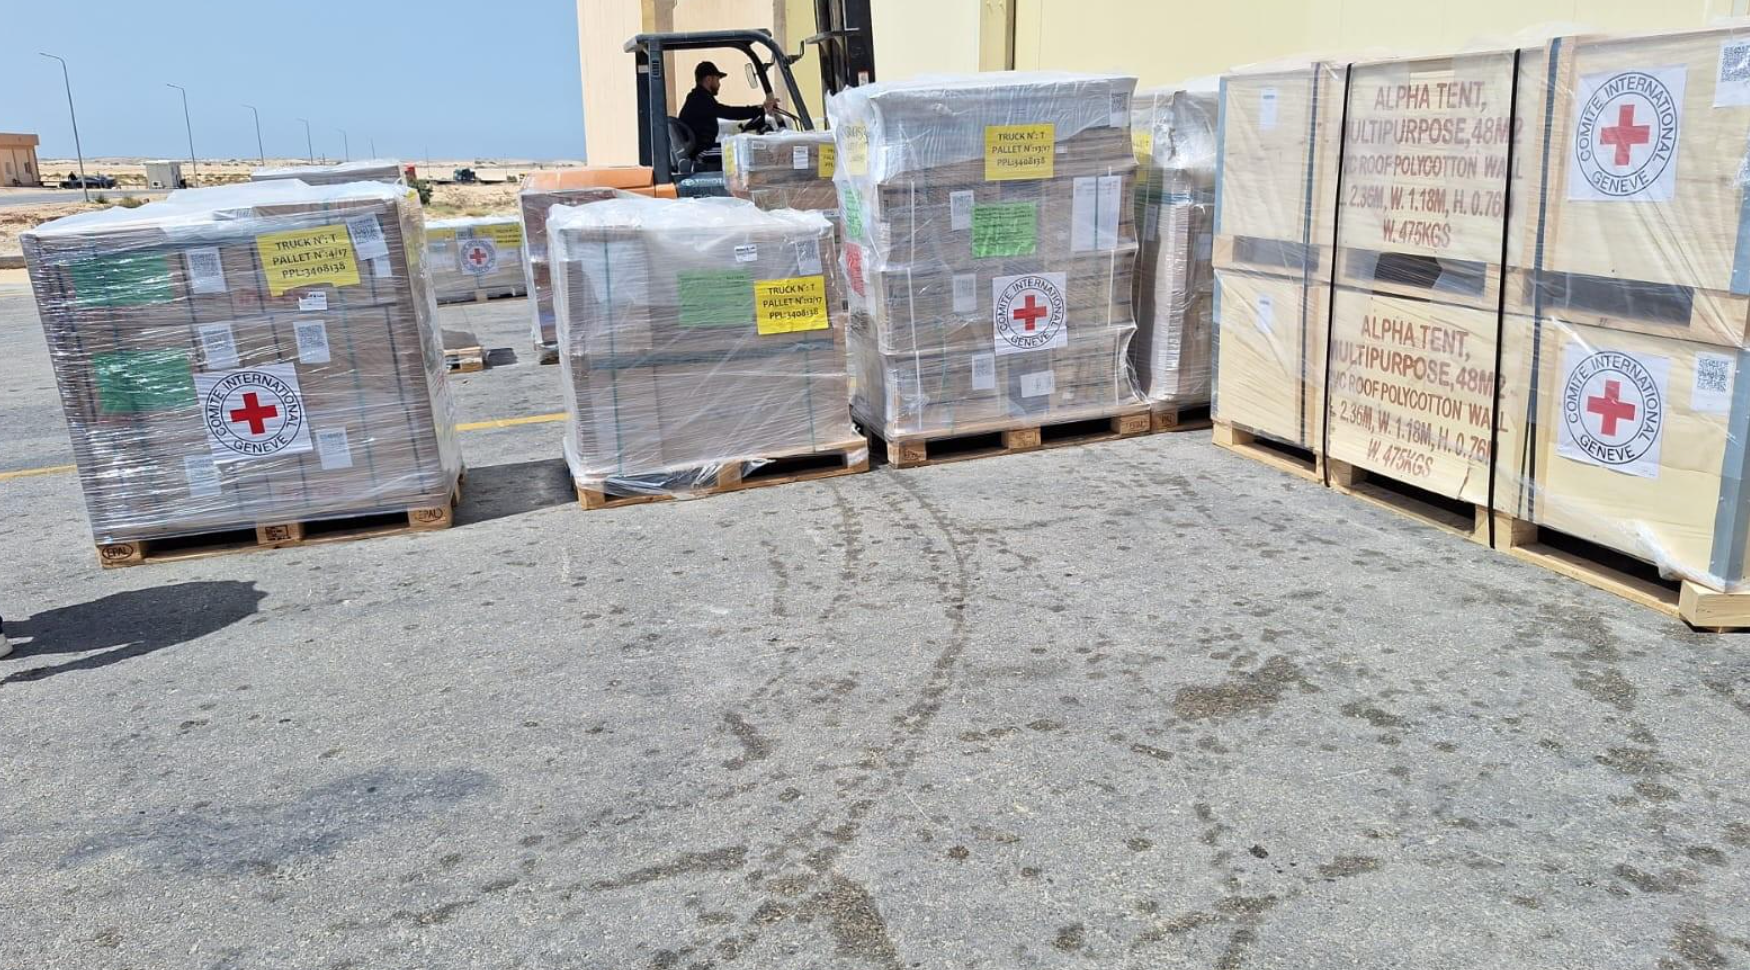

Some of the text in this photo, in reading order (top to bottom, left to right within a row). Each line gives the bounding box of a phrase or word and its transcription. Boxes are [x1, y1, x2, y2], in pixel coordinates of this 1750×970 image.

[1374, 81, 1488, 112] ALPHA TENT,
[1579, 75, 1675, 162] COMITE INTERNATIONAL
[992, 144, 1022, 154] PALLET
[998, 132, 1025, 142] TRUCK
[1592, 170, 1650, 193] GENEVE
[1391, 186, 1405, 210] W.
[1408, 187, 1449, 218] 1.18M,
[1452, 189, 1467, 215] H.
[275, 238, 311, 251] TRUCK
[330, 233, 338, 243] T
[1383, 218, 1451, 248] W. 475KGS
[272, 252, 310, 266] PALLET
[282, 265, 346, 279] PPL:3408138
[762, 298, 793, 309] PALLET
[768, 284, 796, 295] TRUCK
[998, 278, 1063, 332] COMITE INTERNATIONAL
[1010, 331, 1051, 347] GENEVE
[1361, 314, 1471, 362] ALPHA TENT,
[208, 373, 299, 437] COMITE INTERNATIONAL
[1349, 374, 1380, 399] ROOF
[1380, 382, 1463, 421] POLYCOTTON
[1566, 354, 1659, 441] COMITE INTERNATIONAL
[1340, 400, 1375, 434] 2.36M,
[1378, 410, 1391, 435] W.
[1395, 415, 1435, 453] 1.18M,
[1437, 426, 1451, 454] H.
[233, 435, 288, 454] GENEVE
[1366, 437, 1434, 478] W. 475KGS
[1579, 433, 1636, 461] GENEVE
[106, 546, 130, 557] EPAL
